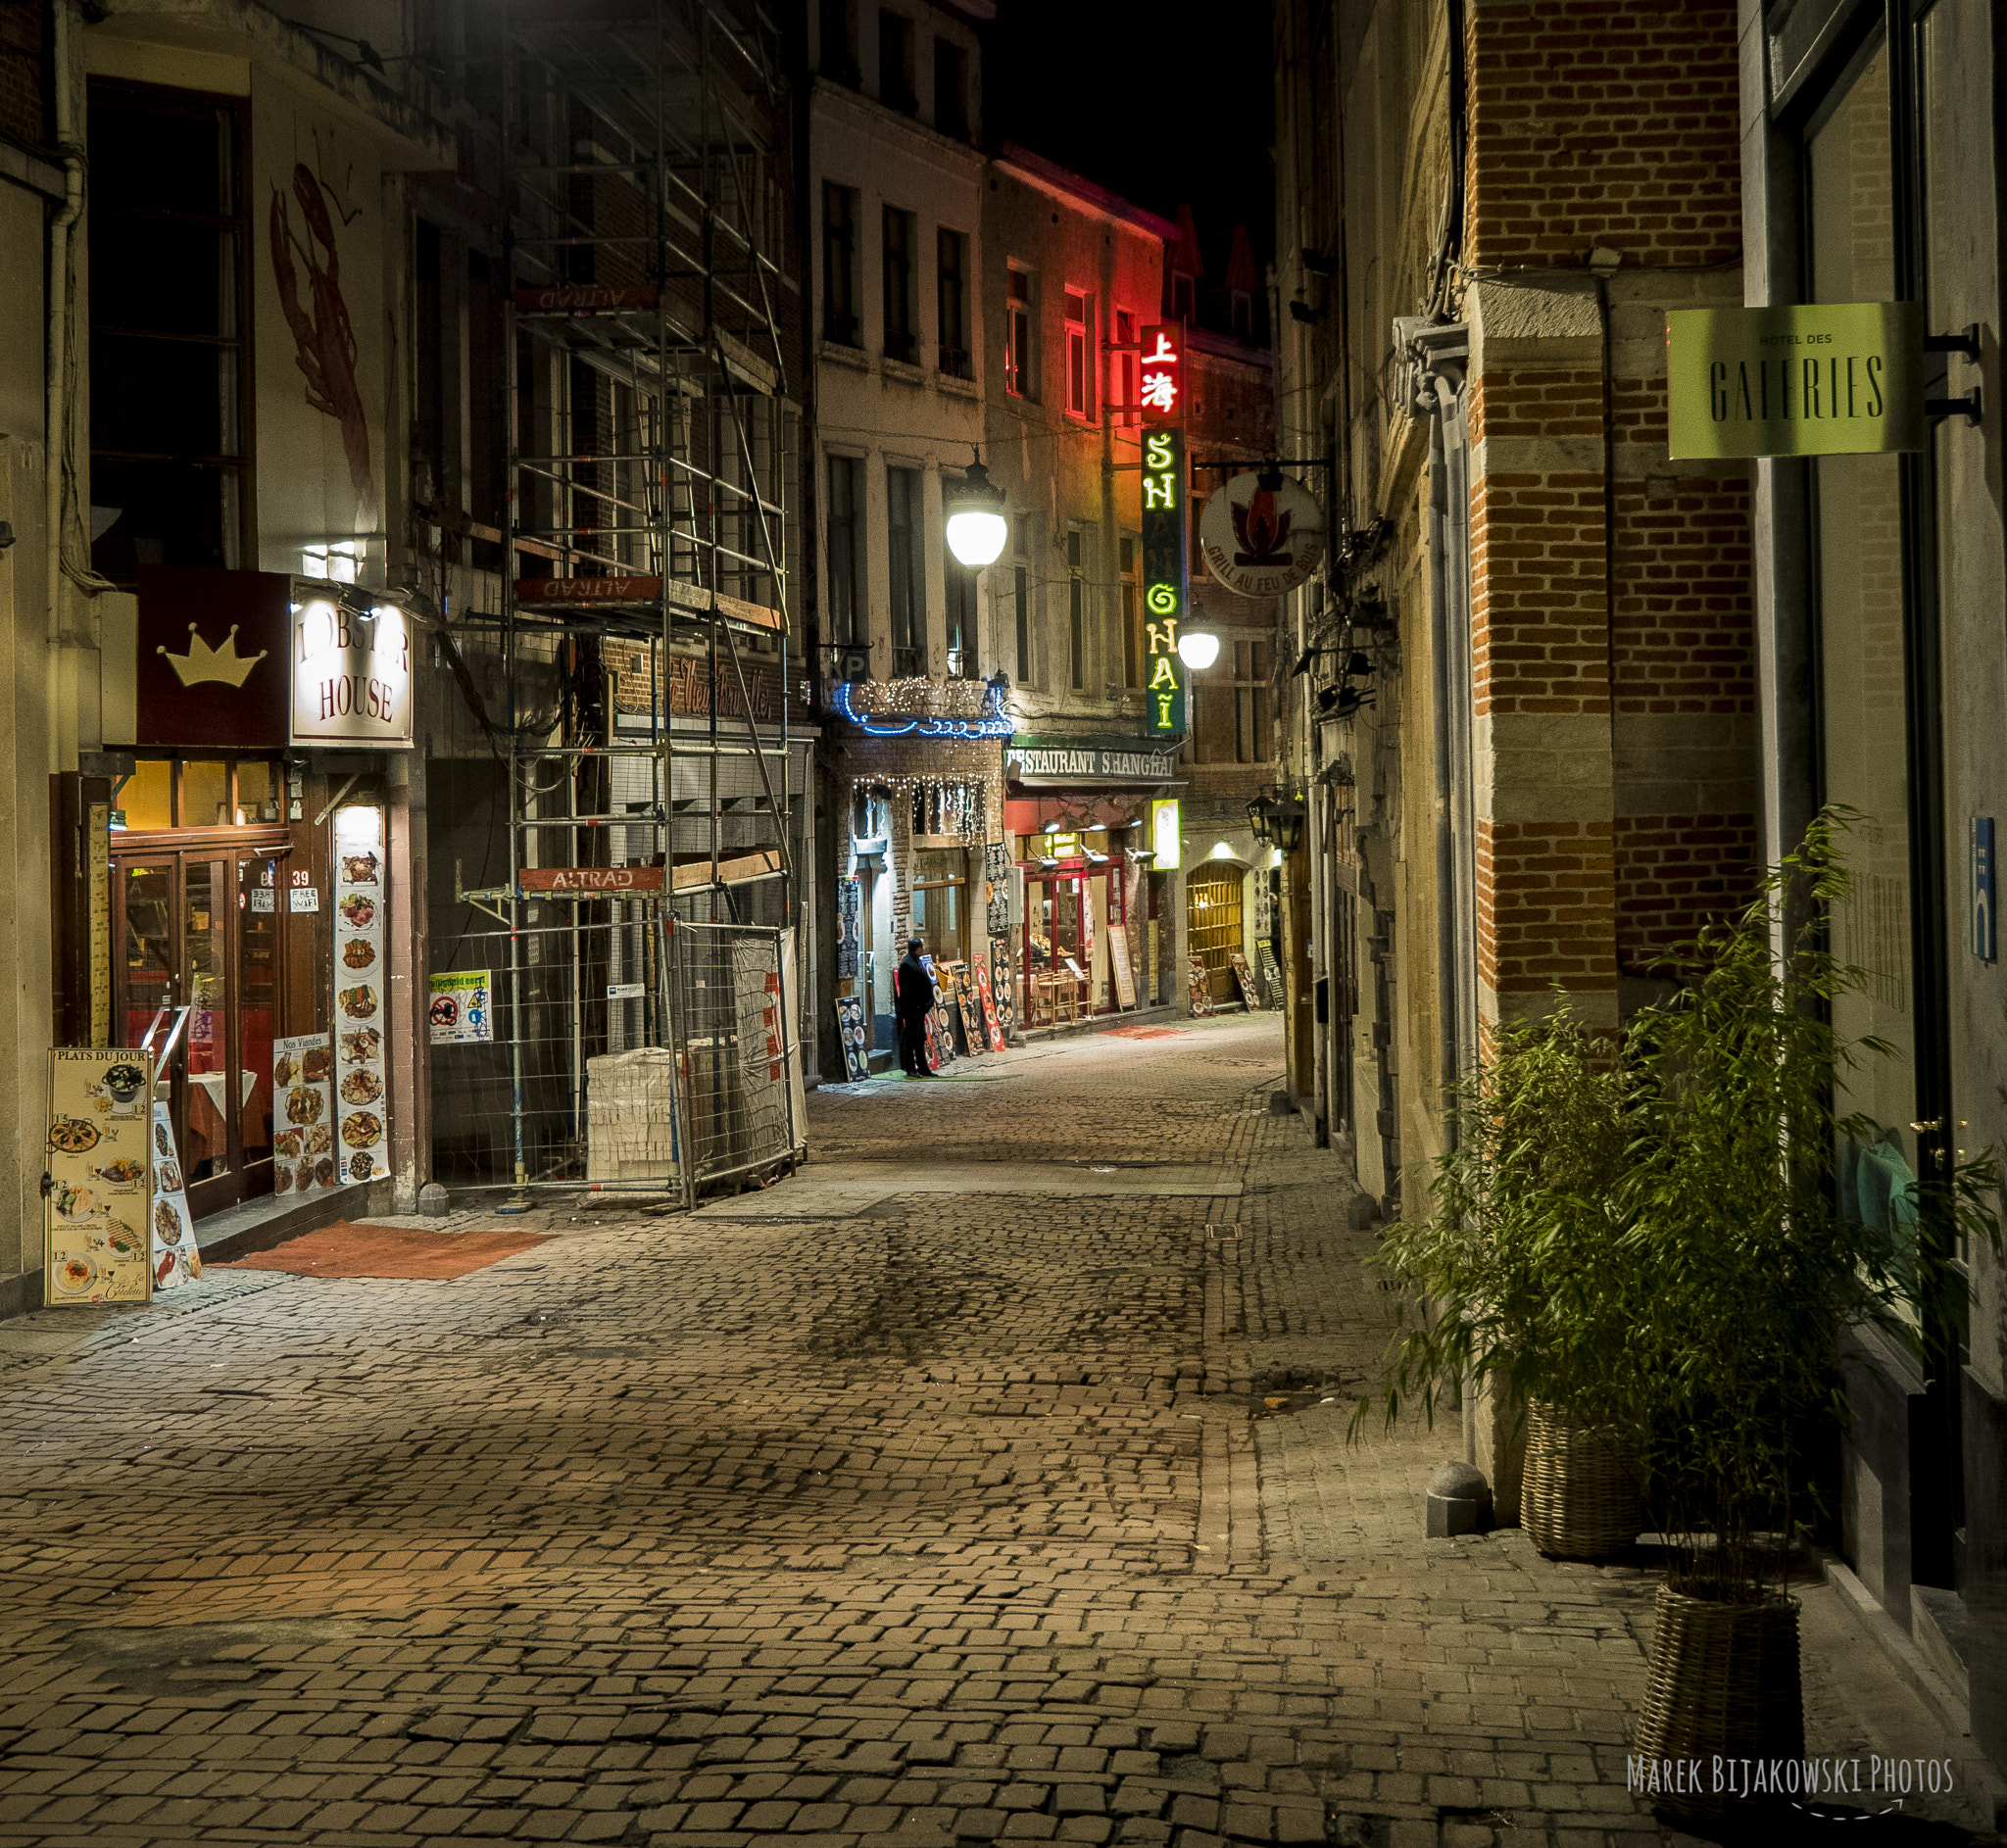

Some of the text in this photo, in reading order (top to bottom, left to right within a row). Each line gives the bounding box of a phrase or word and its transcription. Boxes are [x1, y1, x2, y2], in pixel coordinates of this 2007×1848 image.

[539, 288, 627, 309] ALTRAD
[1760, 333, 1833, 346] HOTEL DES
[1141, 332, 1178, 413] 上海
[1208, 543, 1318, 591] GRILL AU FEU DE BOIS
[543, 579, 632, 598] ALTRAD
[319, 674, 393, 724] HOUSE
[292, 870, 310, 887] 39
[552, 870, 633, 888] ALTRAD
[292, 890, 317, 899] FREE
[292, 899, 317, 907] WIFI
[283, 1036, 322, 1050] Nos Viandes
[58, 1051, 146, 1063] PLATS DU JOUR
